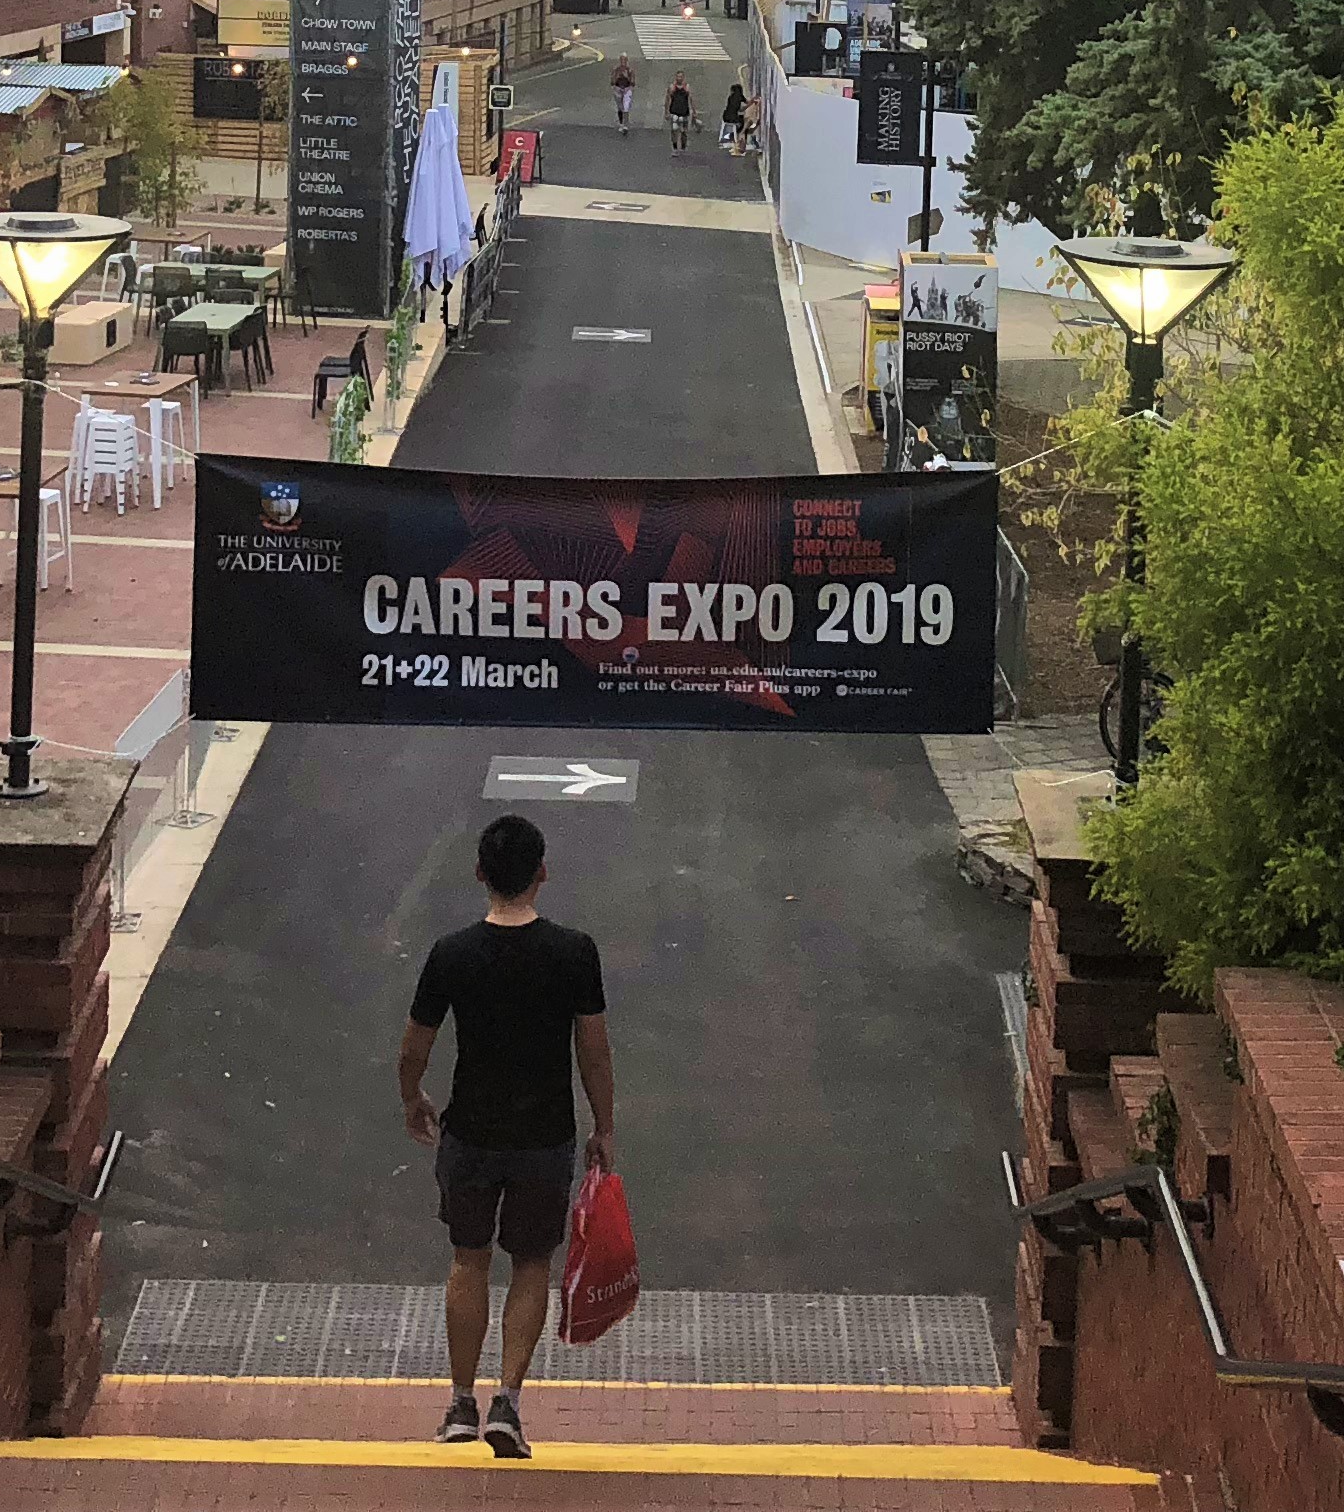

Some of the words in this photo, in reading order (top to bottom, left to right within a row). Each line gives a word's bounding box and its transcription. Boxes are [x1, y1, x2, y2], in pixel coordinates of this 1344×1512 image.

[301, 17, 338, 29] CHOW
[340, 19, 376, 30] TOWN
[301, 40, 331, 51] MAIN
[333, 41, 369, 53] STAGE
[301, 63, 348, 75] BRAGGS
[300, 114, 323, 125] THE
[324, 115, 358, 127] ATTIC
[877, 87, 890, 151] MAKING
[889, 87, 902, 152] HISTORY
[299, 137, 338, 148] LITTLE
[299, 148, 351, 161] THEATRE
[298, 171, 335, 183] UNION
[298, 182, 344, 195] CINEMA
[297, 205, 317, 216] WP
[318, 207, 365, 219] ROGERS
[297, 228, 358, 242] ROBERTA'S
[906, 331, 942, 343] PUSSY
[944, 333, 971, 343] RIOT
[906, 341, 932, 351] RIOT
[934, 341, 963, 352] DAYS
[792, 499, 862, 517] CONNECT
[793, 519, 812, 536] TO
[218, 534, 248, 548] THE
[253, 535, 343, 551] UNIVERSITY
[793, 539, 882, 557] EMPLOYERS
[792, 559, 823, 575] AND
[828, 557, 896, 576] CAREERS
[363, 574, 623, 640] CAREERS
[647, 582, 794, 642] EXPO
[816, 581, 954, 645] 2019
[361, 654, 449, 687] 21+22
[461, 656, 559, 688] March
[598, 662, 632, 675] Find
[636, 665, 659, 675] out
[663, 666, 706, 676] more:
[710, 664, 877, 681] ua.edu.au/careers-expo
[598, 681, 615, 691] or
[618, 681, 639, 693] get
[643, 679, 666, 691] the
[670, 679, 720, 692] Career
[724, 680, 755, 693] Fair
[759, 680, 790, 694] Plus
[794, 685, 821, 696] app
